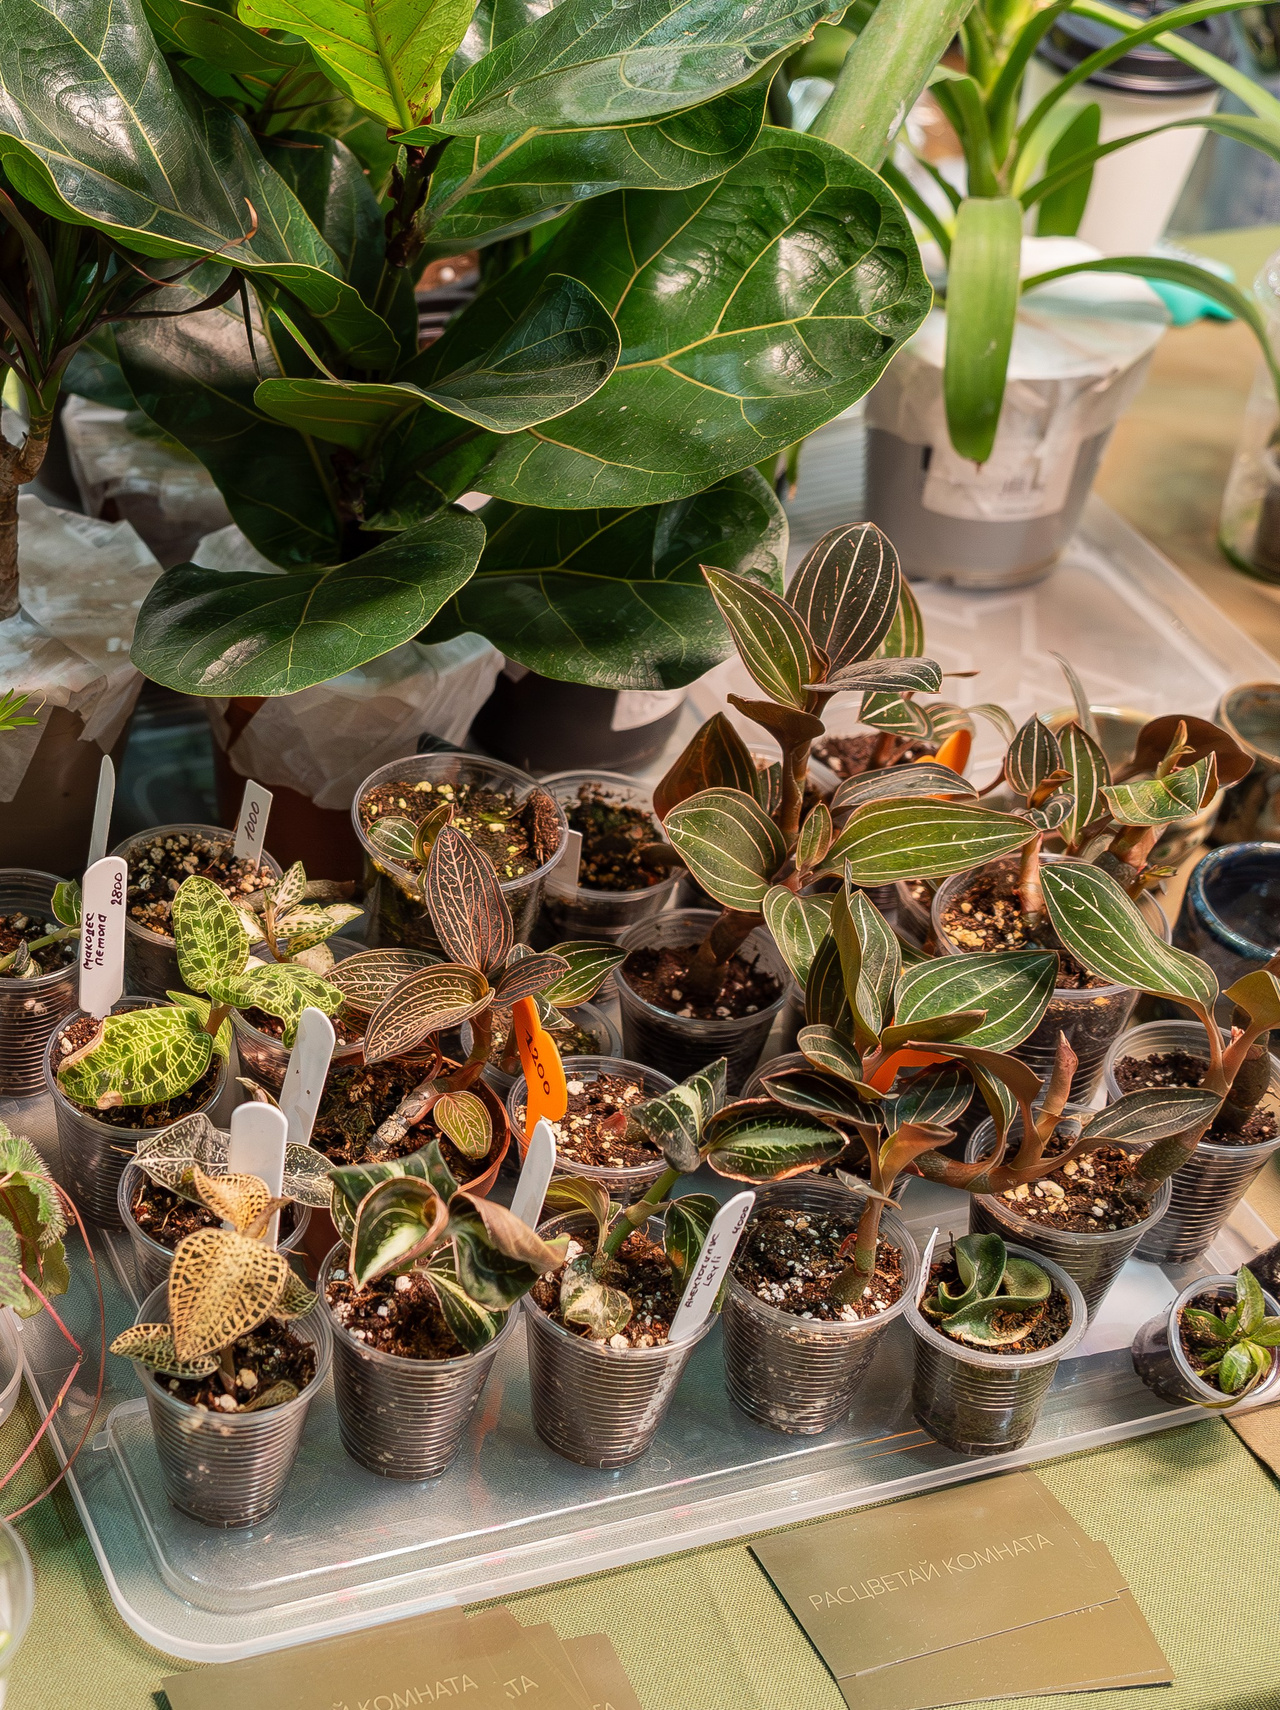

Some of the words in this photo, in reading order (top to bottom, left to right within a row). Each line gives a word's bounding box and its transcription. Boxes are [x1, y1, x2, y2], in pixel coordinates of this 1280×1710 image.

[244, 801, 260, 842] 1000
[110, 872, 123, 906] 2800
[731, 1205, 750, 1235] 4000
[808, 1560, 942, 1611] РАСЦВЕТАЙ
[941, 1533, 1055, 1575] КОМНАТА
